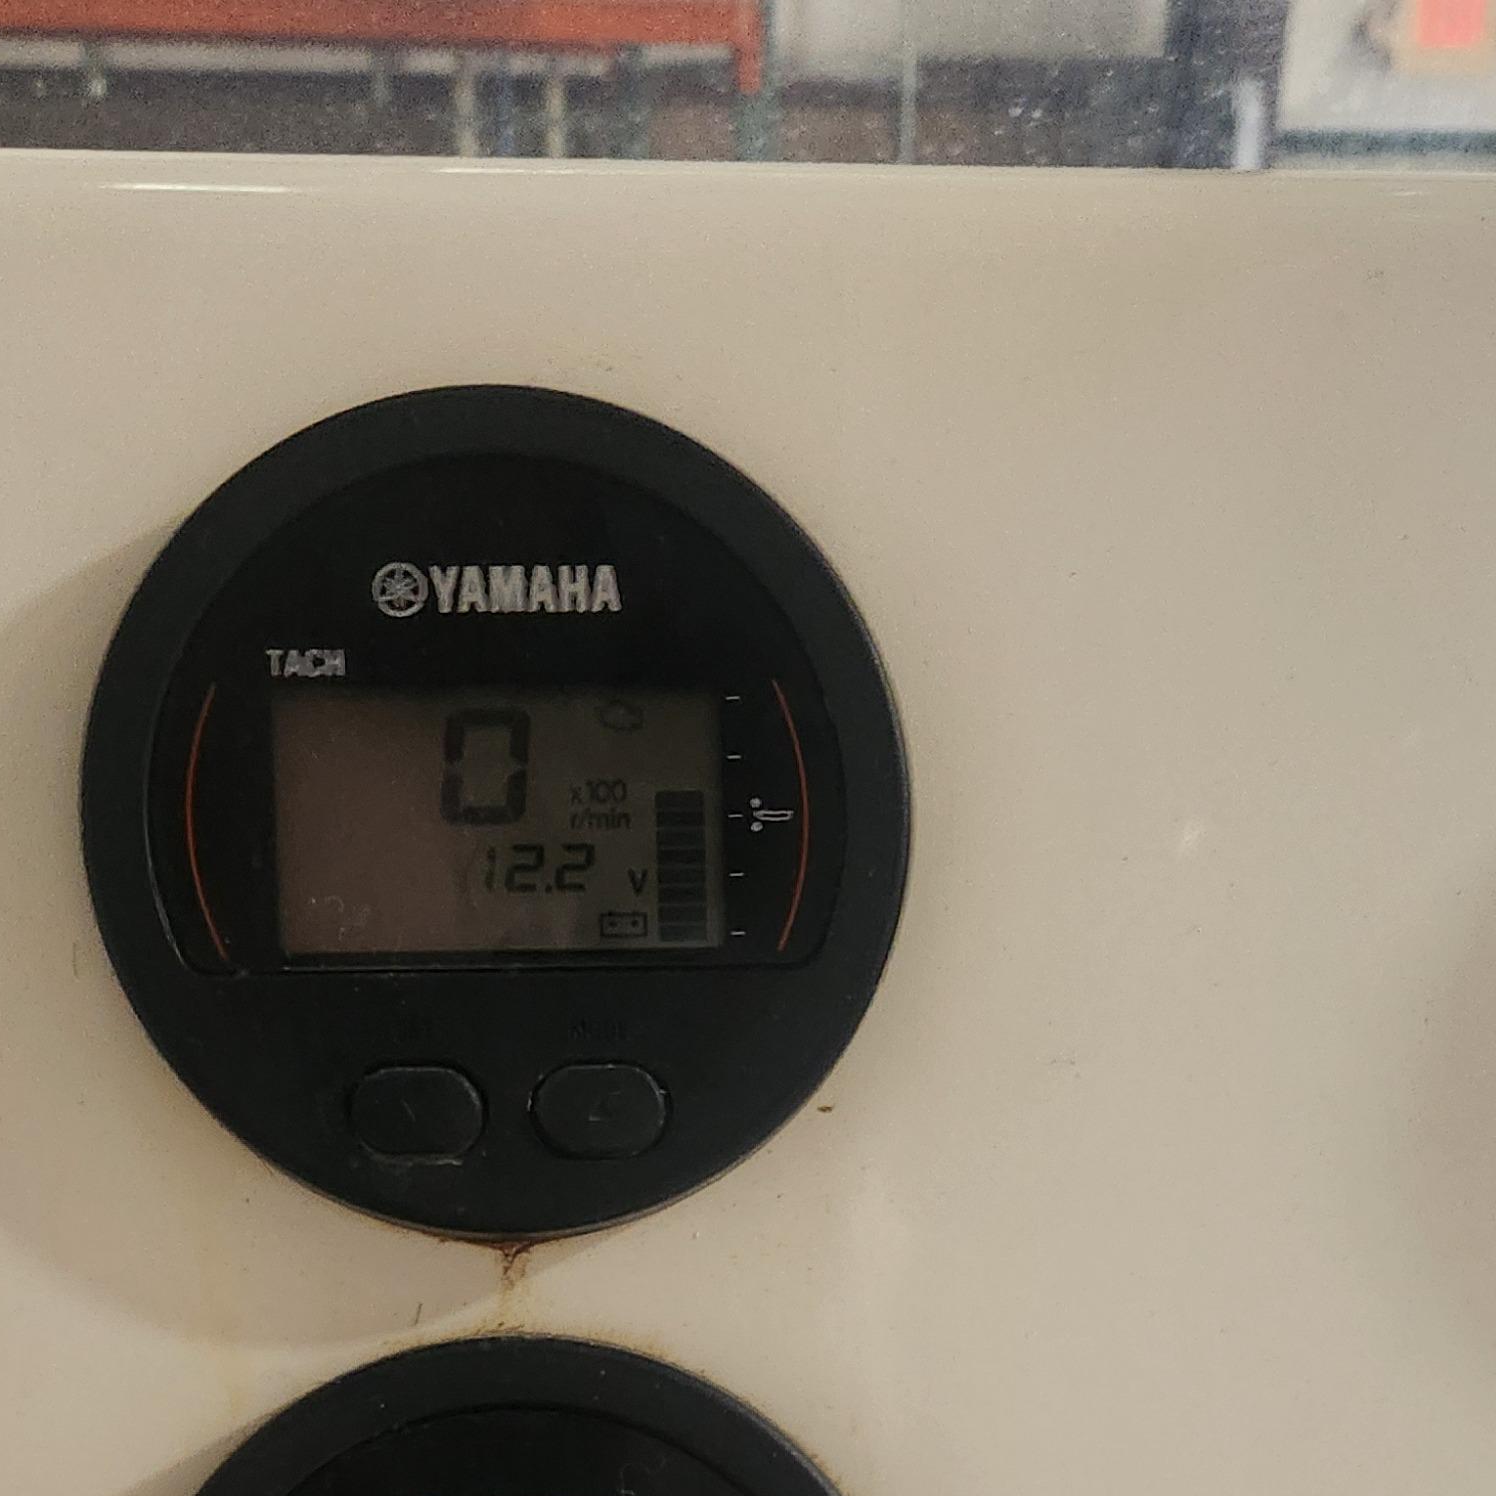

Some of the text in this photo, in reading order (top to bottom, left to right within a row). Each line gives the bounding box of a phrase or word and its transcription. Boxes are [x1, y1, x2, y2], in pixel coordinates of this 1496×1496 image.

[427, 564, 623, 614] YAMAHA
[266, 647, 346, 677] TACH
[440, 707, 531, 827] 0
[568, 779, 628, 804] x100
[569, 807, 632, 830] r/min
[484, 842, 595, 893] 12.2
